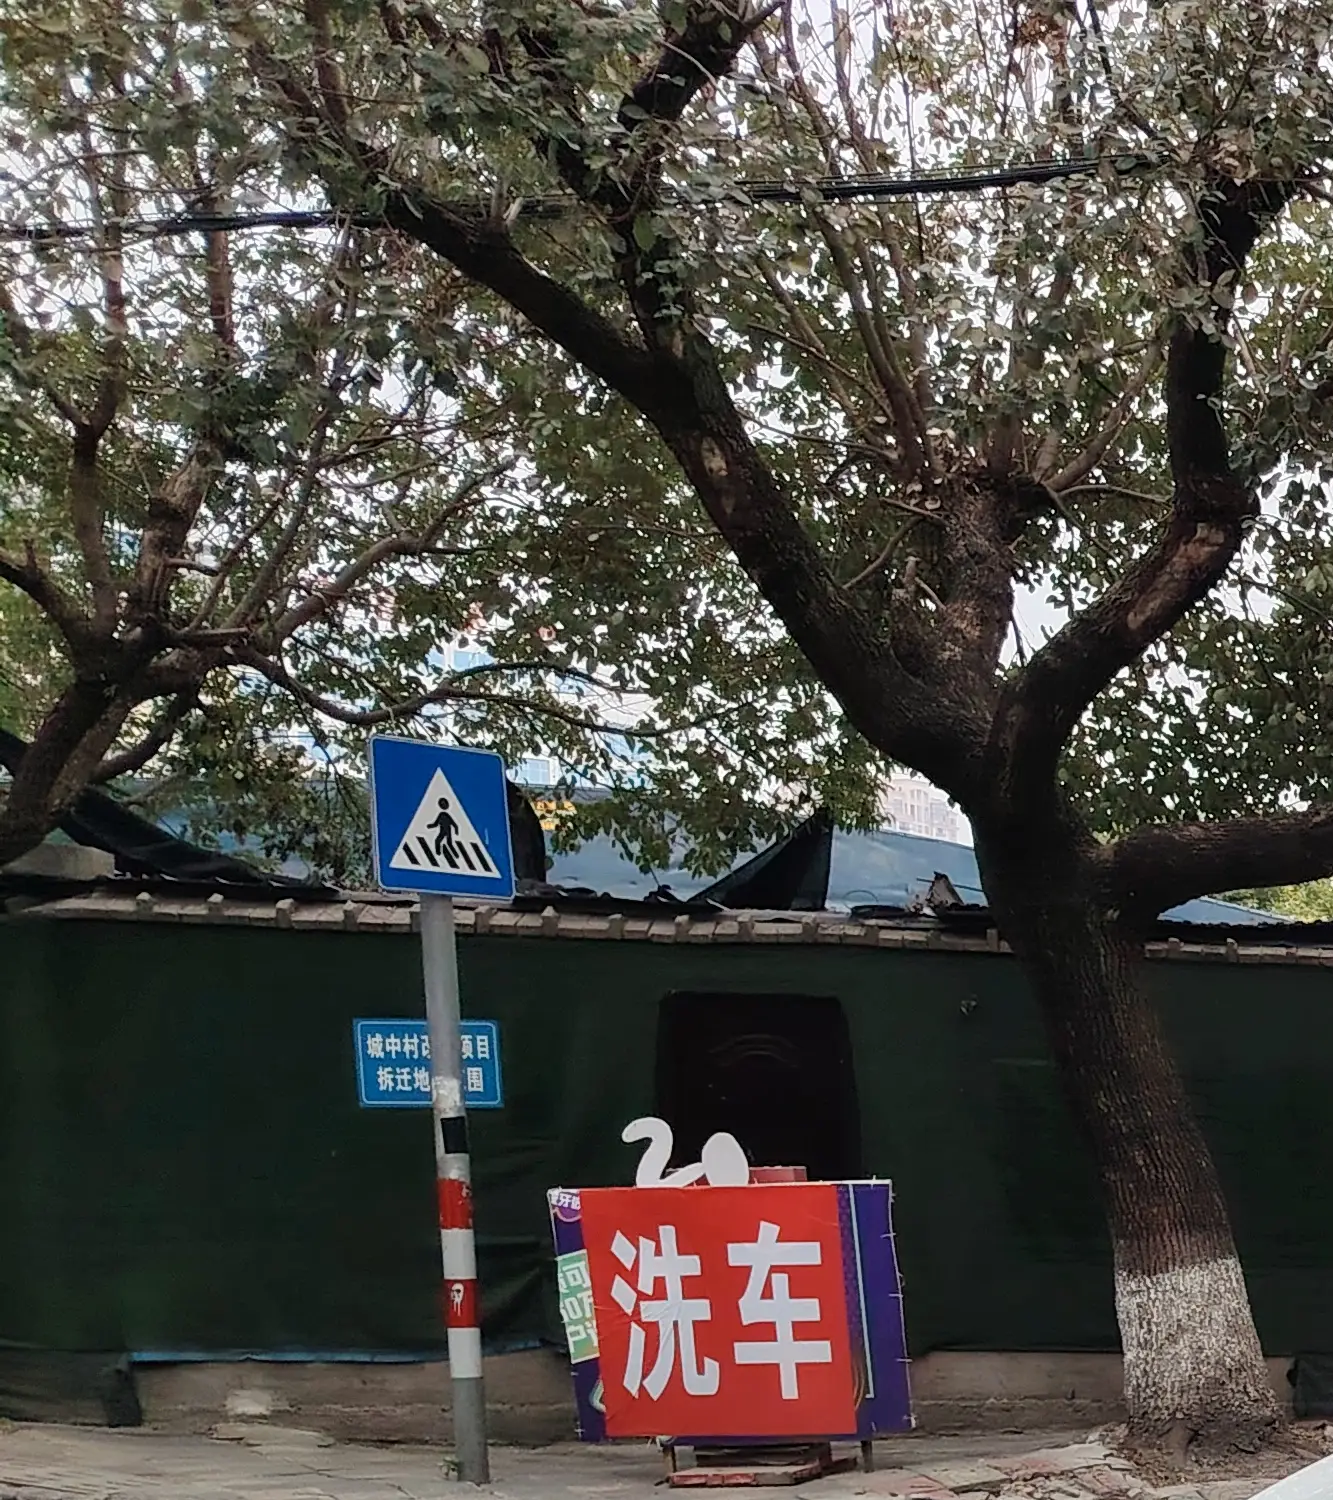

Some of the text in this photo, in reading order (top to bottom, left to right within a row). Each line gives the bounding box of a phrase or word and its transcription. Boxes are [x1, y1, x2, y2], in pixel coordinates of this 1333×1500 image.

[366, 1033, 490, 1060] 城中村改项目
[376, 1065, 484, 1092] 拆迁地围
[609, 1220, 833, 1401] 洗车
